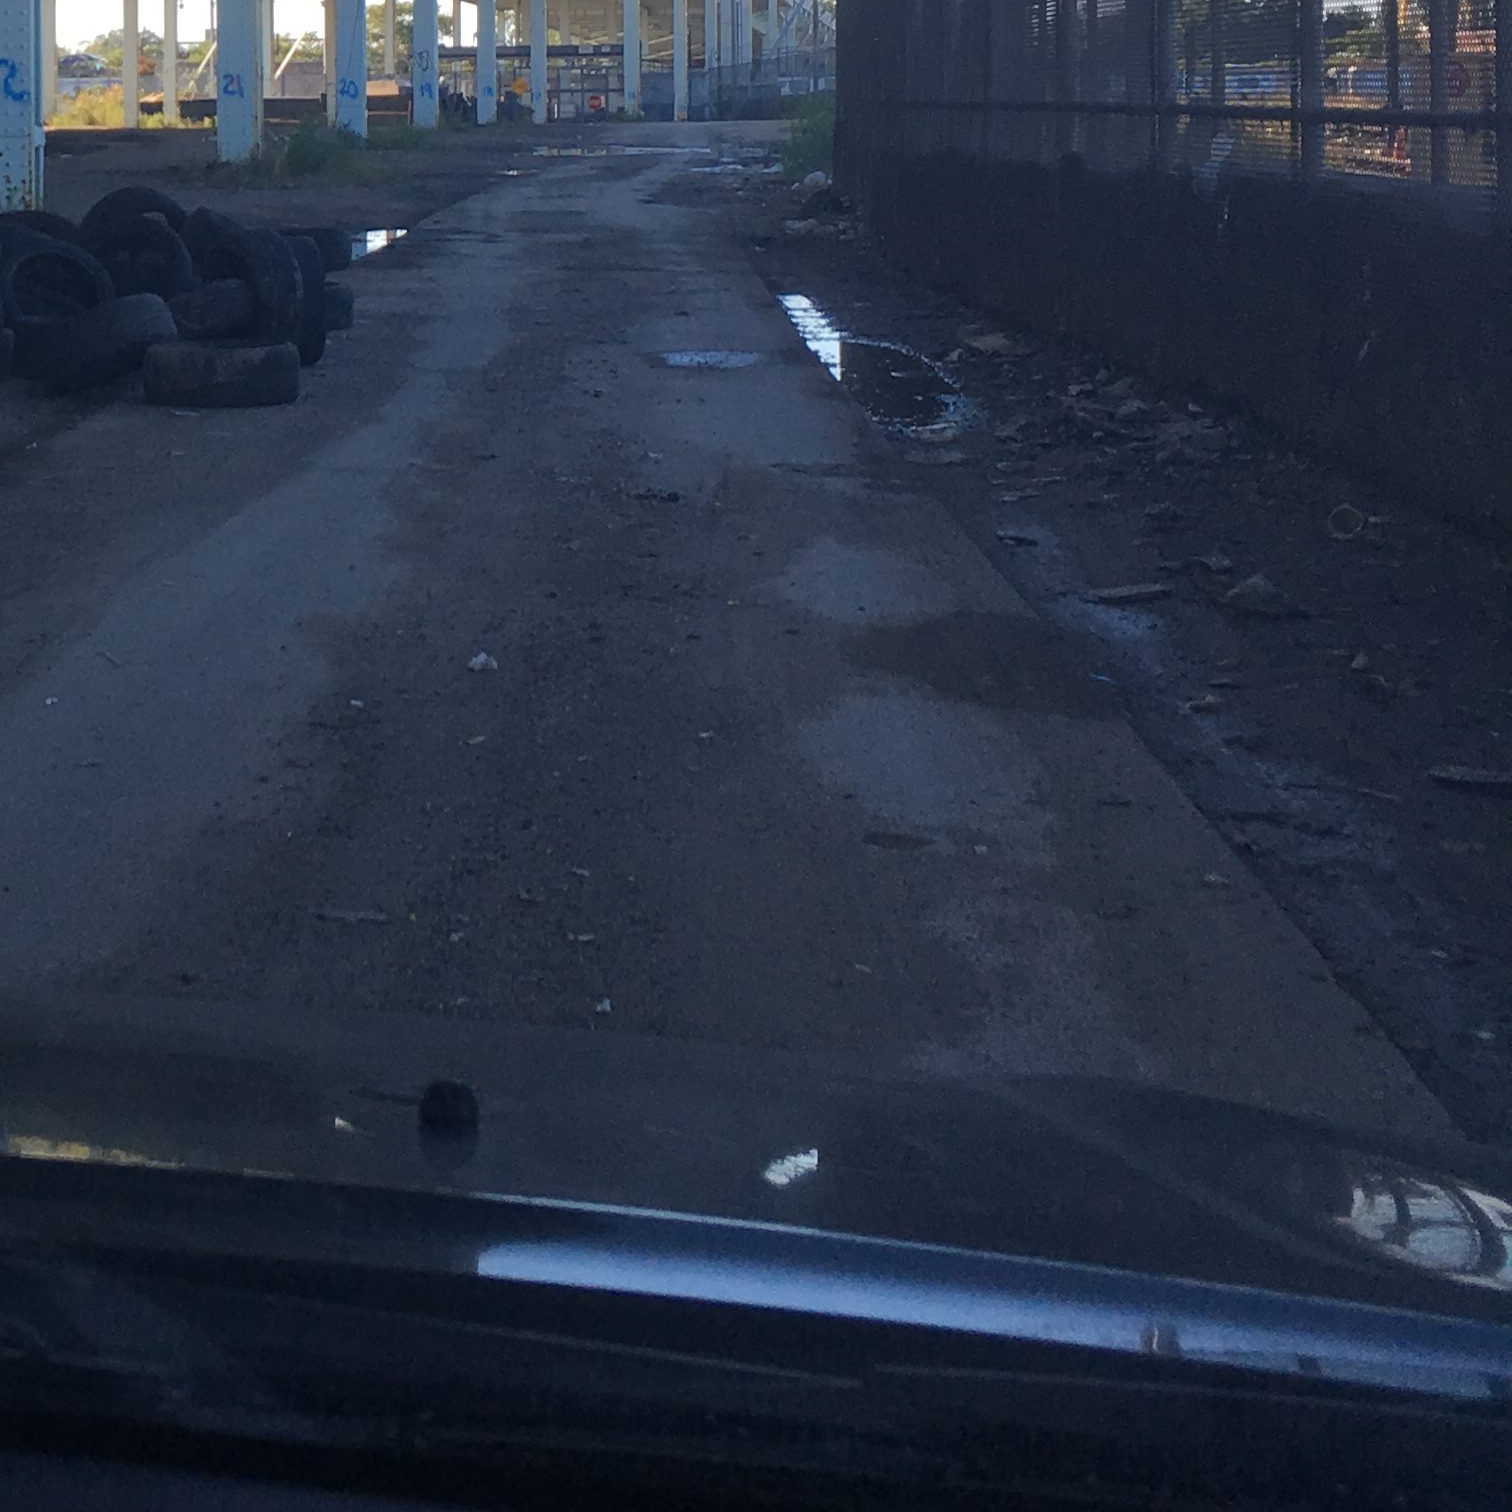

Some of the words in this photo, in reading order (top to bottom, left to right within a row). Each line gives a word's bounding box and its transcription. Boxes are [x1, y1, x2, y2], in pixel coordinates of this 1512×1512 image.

[222, 72, 245, 98] 21
[339, 78, 359, 100] 20
[420, 83, 433, 98] 19
